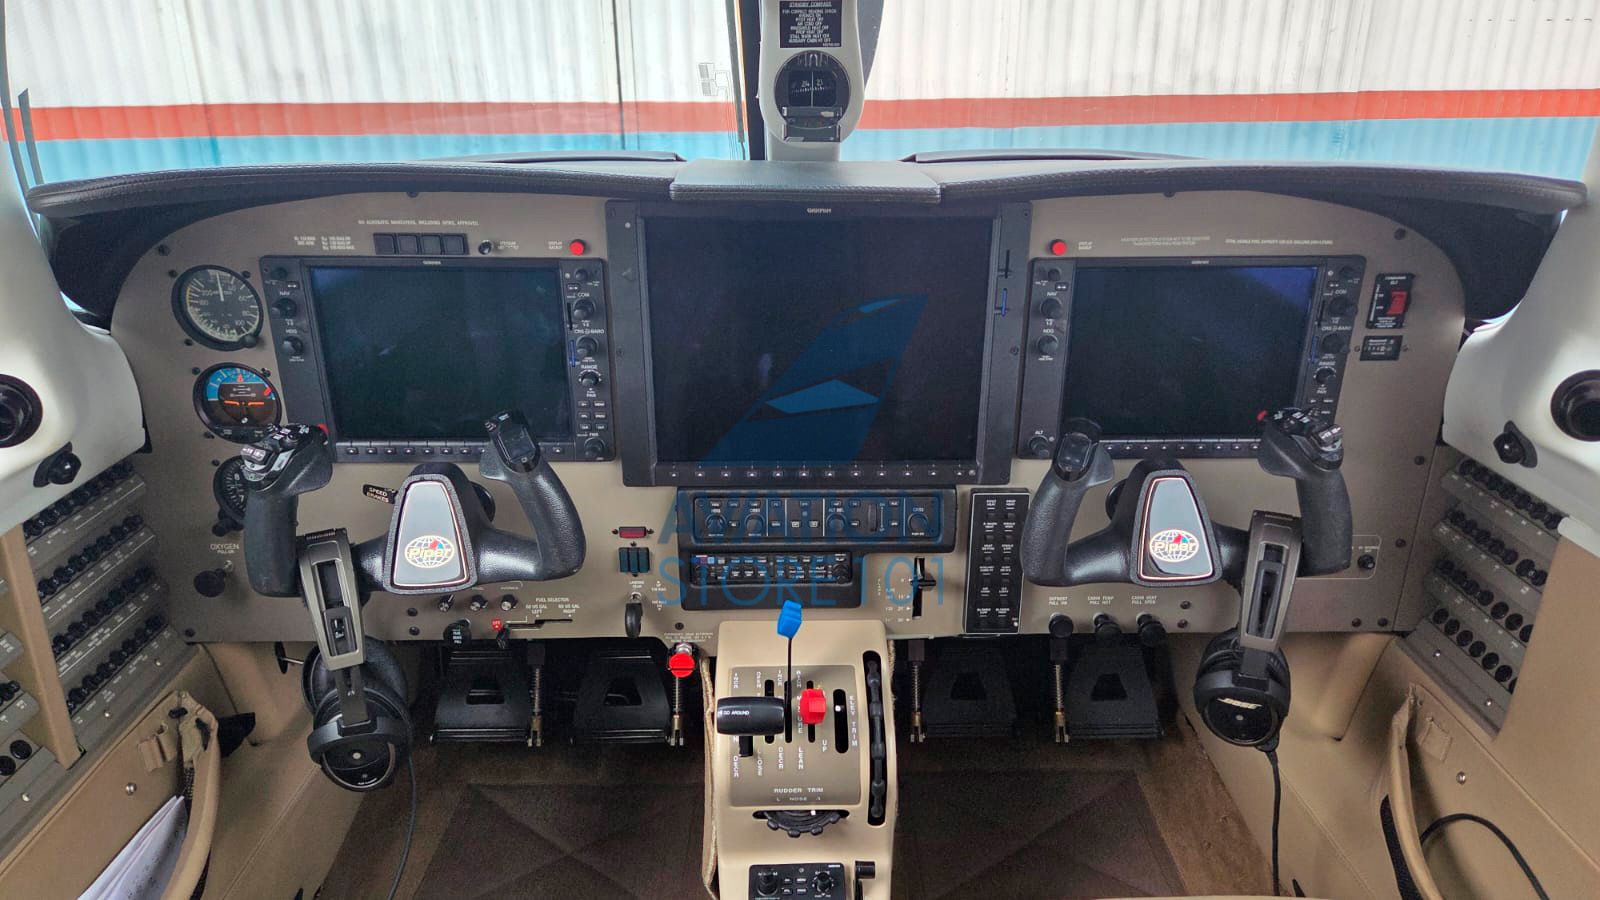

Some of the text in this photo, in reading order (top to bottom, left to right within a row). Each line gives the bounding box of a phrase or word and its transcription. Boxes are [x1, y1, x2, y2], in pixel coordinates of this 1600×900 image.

[369, 487, 388, 497] SPEED
[407, 547, 451, 560] Piper
[1154, 541, 1197, 554] Piper
[822, 740, 828, 752] UP
